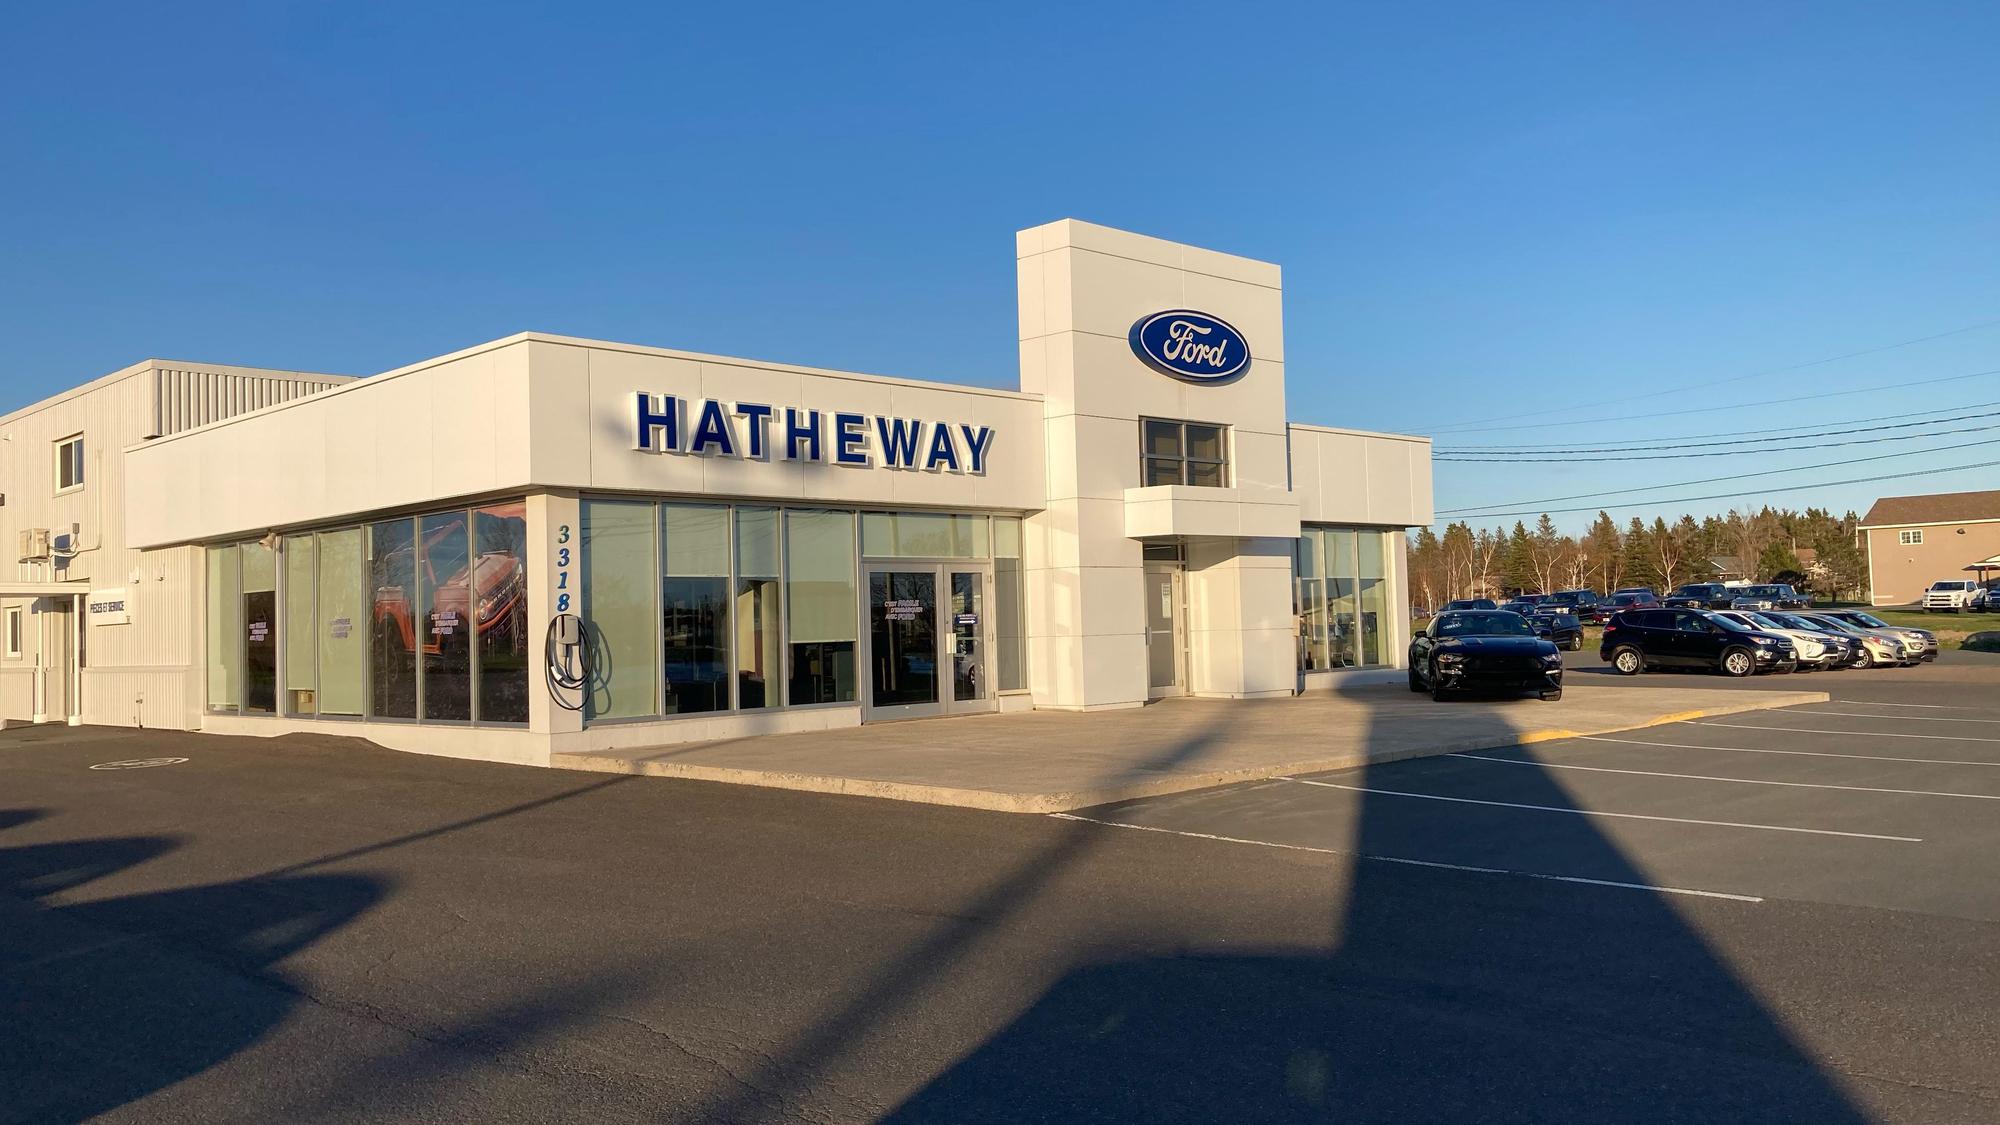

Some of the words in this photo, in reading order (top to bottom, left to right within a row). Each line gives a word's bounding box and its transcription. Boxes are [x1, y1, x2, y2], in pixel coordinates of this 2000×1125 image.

[1163, 320, 1228, 368] Ford
[634, 391, 992, 475] HATHEWAY
[557, 525, 571, 612] 3318
